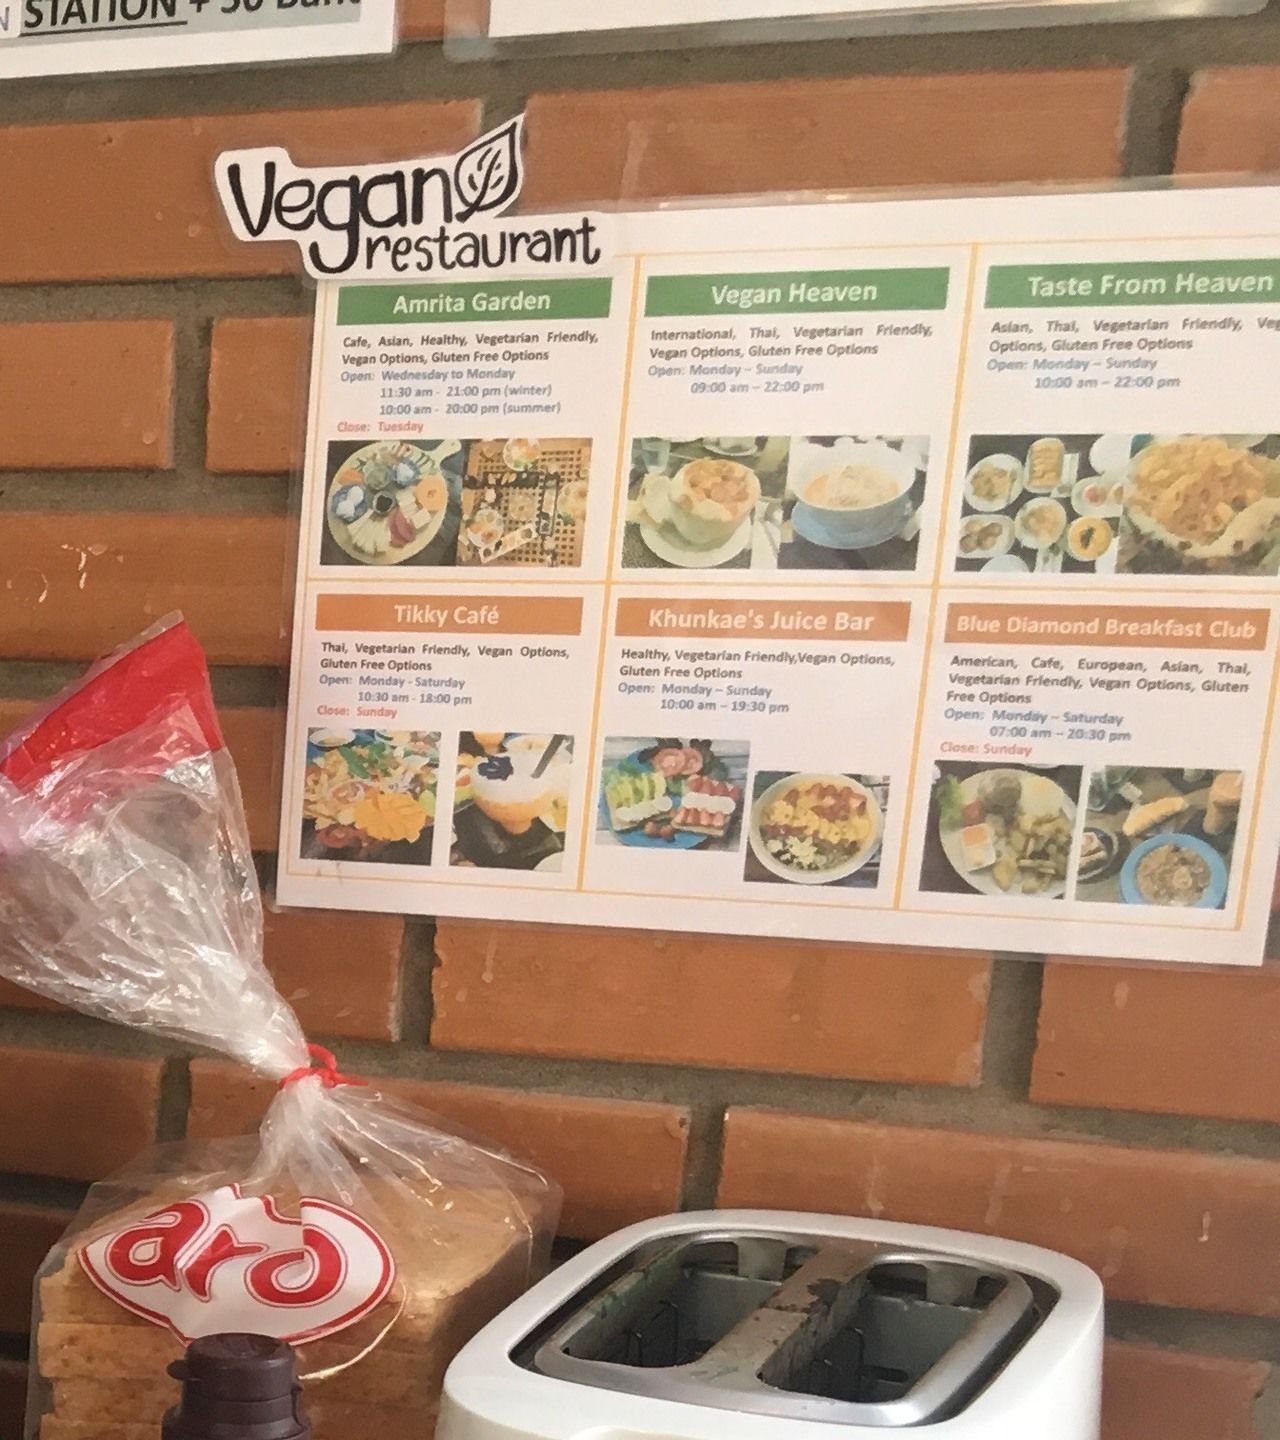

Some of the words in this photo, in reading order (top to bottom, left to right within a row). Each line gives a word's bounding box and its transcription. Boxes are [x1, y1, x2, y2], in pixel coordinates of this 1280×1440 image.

[24, 0, 176, 28] STATION
[228, 161, 453, 273] Vegan
[366, 217, 600, 272] restaurant
[1028, 276, 1092, 296] Taste
[1100, 276, 1166, 294] From
[1175, 273, 1273, 294] Heaven
[393, 293, 465, 315] Amrita
[472, 291, 551, 311] Garden
[712, 284, 781, 308] Vegan
[789, 283, 877, 303] Heaven
[343, 337, 371, 349] Cafe,
[379, 336, 413, 347] Asian,
[421, 334, 468, 346] Healthy,
[476, 333, 539, 345] Vegetarian
[547, 330, 598, 344] Friendly,
[651, 327, 736, 341] International,
[749, 327, 780, 340] Thai,
[793, 326, 863, 339] Vegetarian
[877, 324, 933, 337] Friendly,
[342, 354, 376, 366] Vegan
[380, 352, 428, 365] Options,
[431, 351, 470, 363] Gluten
[474, 351, 498, 361] Free
[502, 350, 548, 363] Options
[381, 369, 448, 382] Wednesday
[451, 370, 462, 379] to
[467, 368, 515, 380] Monday
[380, 387, 411, 398] 11:30
[415, 389, 432, 397] am
[447, 386, 479, 397] 21:00
[482, 388, 500, 399] pm
[504, 384, 552, 398] (winter)
[378, 421, 424, 433] Tuesday
[394, 604, 448, 627] Tikky
[453, 605, 499, 625] Café
[649, 609, 764, 629] Khunkae's
[769, 610, 827, 630] Juice
[834, 612, 874, 631] Bar
[957, 616, 1001, 633] Blue
[1007, 616, 1099, 635] Diamond
[1105, 618, 1203, 636] Breakfast
[1209, 620, 1256, 638] Club
[322, 642, 348, 654] Thai,
[355, 643, 415, 657] Vegetarian
[422, 644, 470, 657] Friendly,
[478, 646, 512, 658] Vegan
[520, 647, 569, 659] Options,
[321, 658, 357, 670] Gluten
[361, 659, 385, 670] Free
[388, 660, 432, 672] Options
[619, 666, 660, 677] Gluten
[664, 667, 690, 677] Free
[694, 667, 742, 679] Options
[950, 656, 1018, 669] American,
[1031, 657, 1063, 670] Cafe,
[1078, 659, 1147, 673] European,
[1160, 661, 1203, 674] Asian,
[1218, 662, 1251, 675] Thai,
